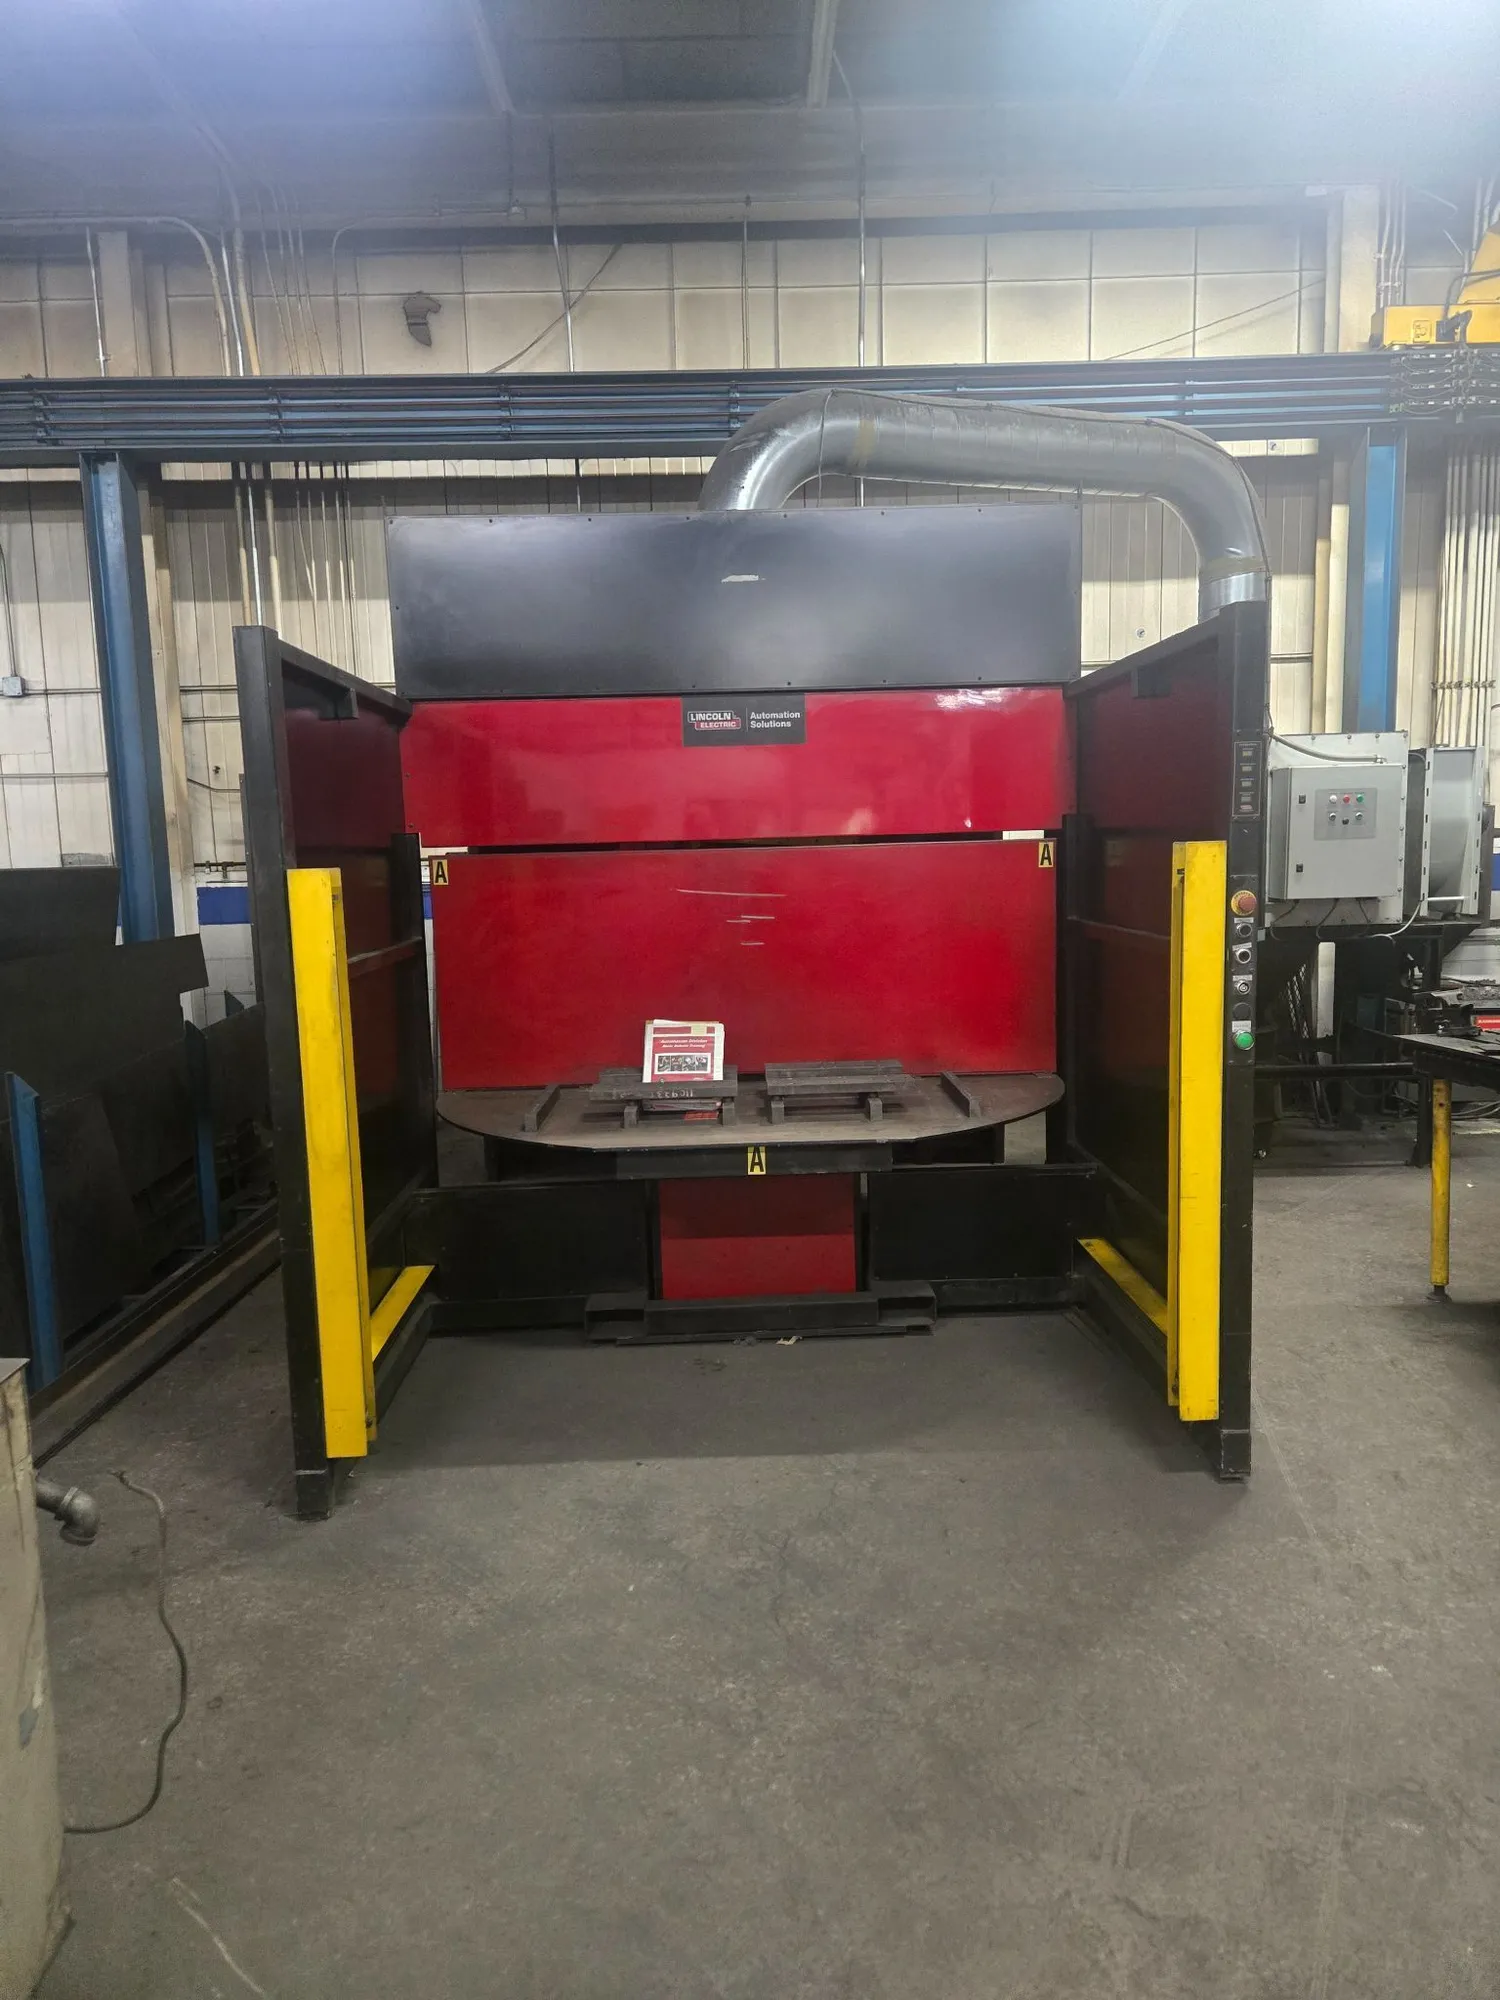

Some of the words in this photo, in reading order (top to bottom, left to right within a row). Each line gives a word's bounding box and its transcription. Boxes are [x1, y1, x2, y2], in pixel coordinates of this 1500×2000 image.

[690, 712, 731, 721] LINCOLN
[750, 711, 800, 720] Automation
[750, 720, 792, 729] Solutions
[1040, 843, 1052, 866] A
[435, 861, 448, 884] A
[750, 1146, 764, 1172] A
